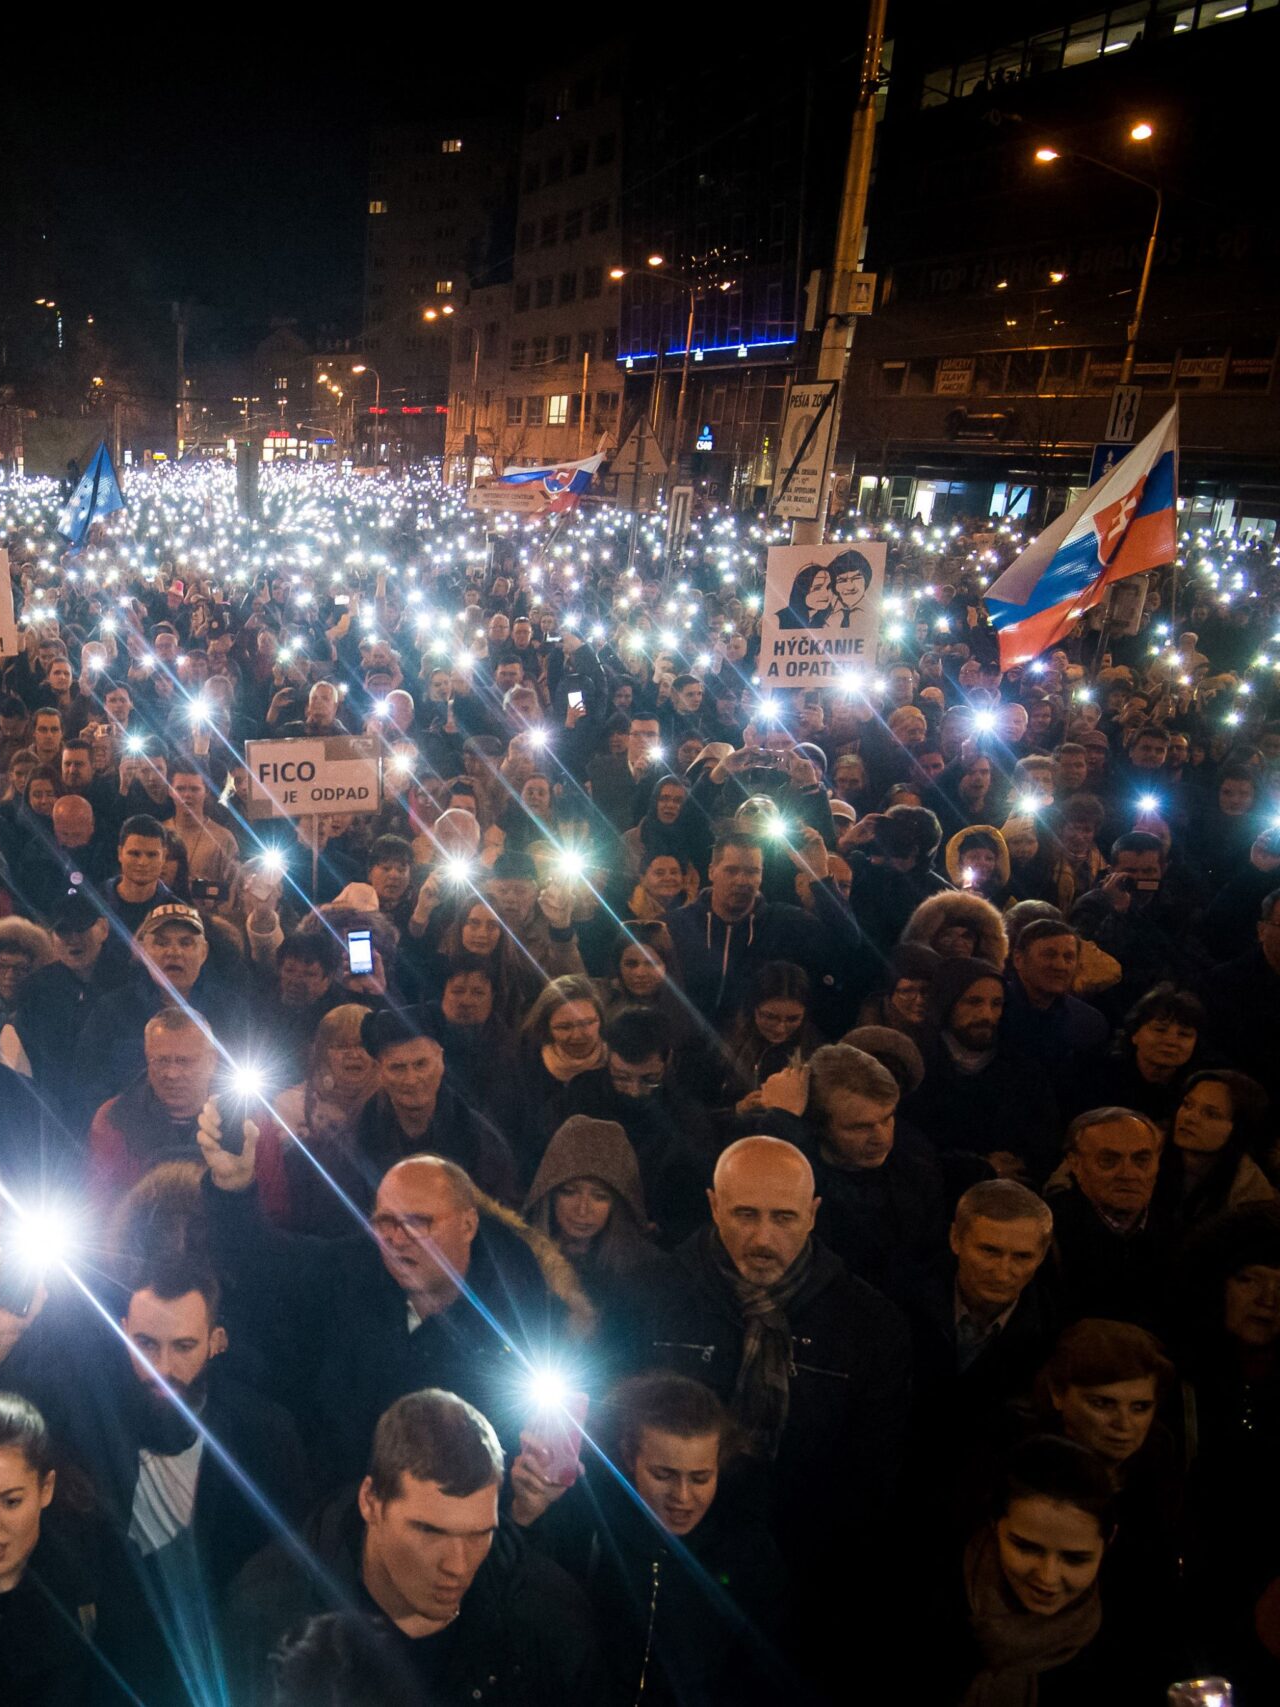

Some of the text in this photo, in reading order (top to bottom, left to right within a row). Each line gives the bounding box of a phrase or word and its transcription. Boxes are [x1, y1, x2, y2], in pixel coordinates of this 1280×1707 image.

[773, 636, 865, 656] HÝČKANIE
[767, 662, 780, 677] A
[258, 761, 316, 784] FICO
[282, 786, 369, 804] JE ODPAD
